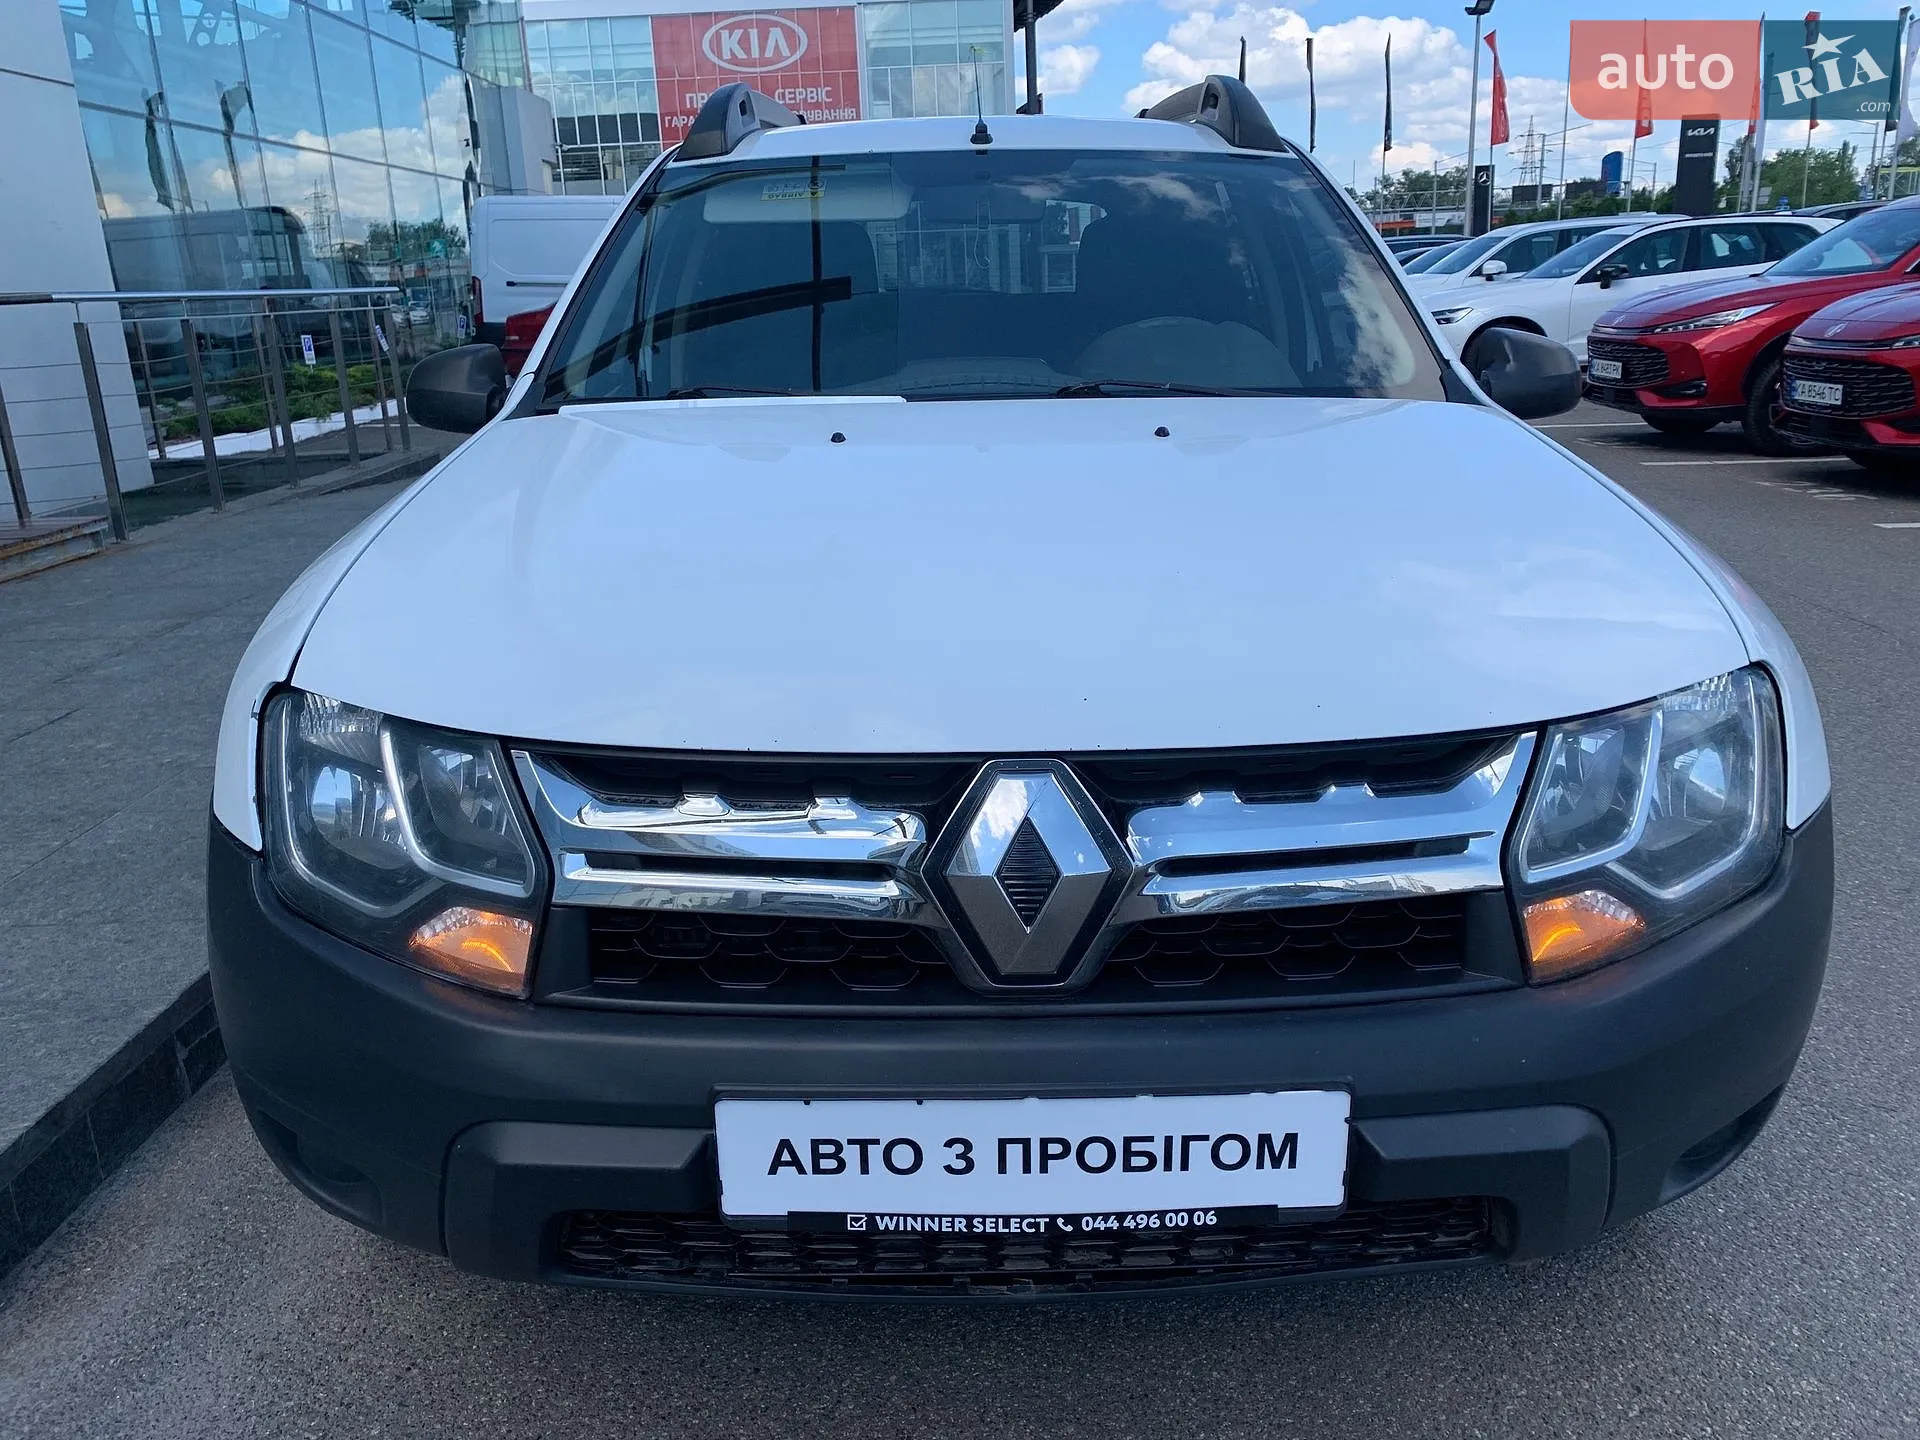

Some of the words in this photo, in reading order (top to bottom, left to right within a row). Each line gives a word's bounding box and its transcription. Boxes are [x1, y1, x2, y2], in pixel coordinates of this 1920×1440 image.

[718, 26, 792, 60] KIA
[774, 86, 833, 105] СЕРВІС
[767, 1137, 924, 1176] АВТО
[996, 1132, 1299, 1175] ПРОБІГОМ
[875, 1215, 968, 1233] WINNER
[972, 1217, 1050, 1233] SELECT
[1081, 1215, 1120, 1232] 044
[1123, 1213, 1161, 1230] 496
[1165, 1211, 1189, 1228] 00
[1193, 1209, 1218, 1226] 06
